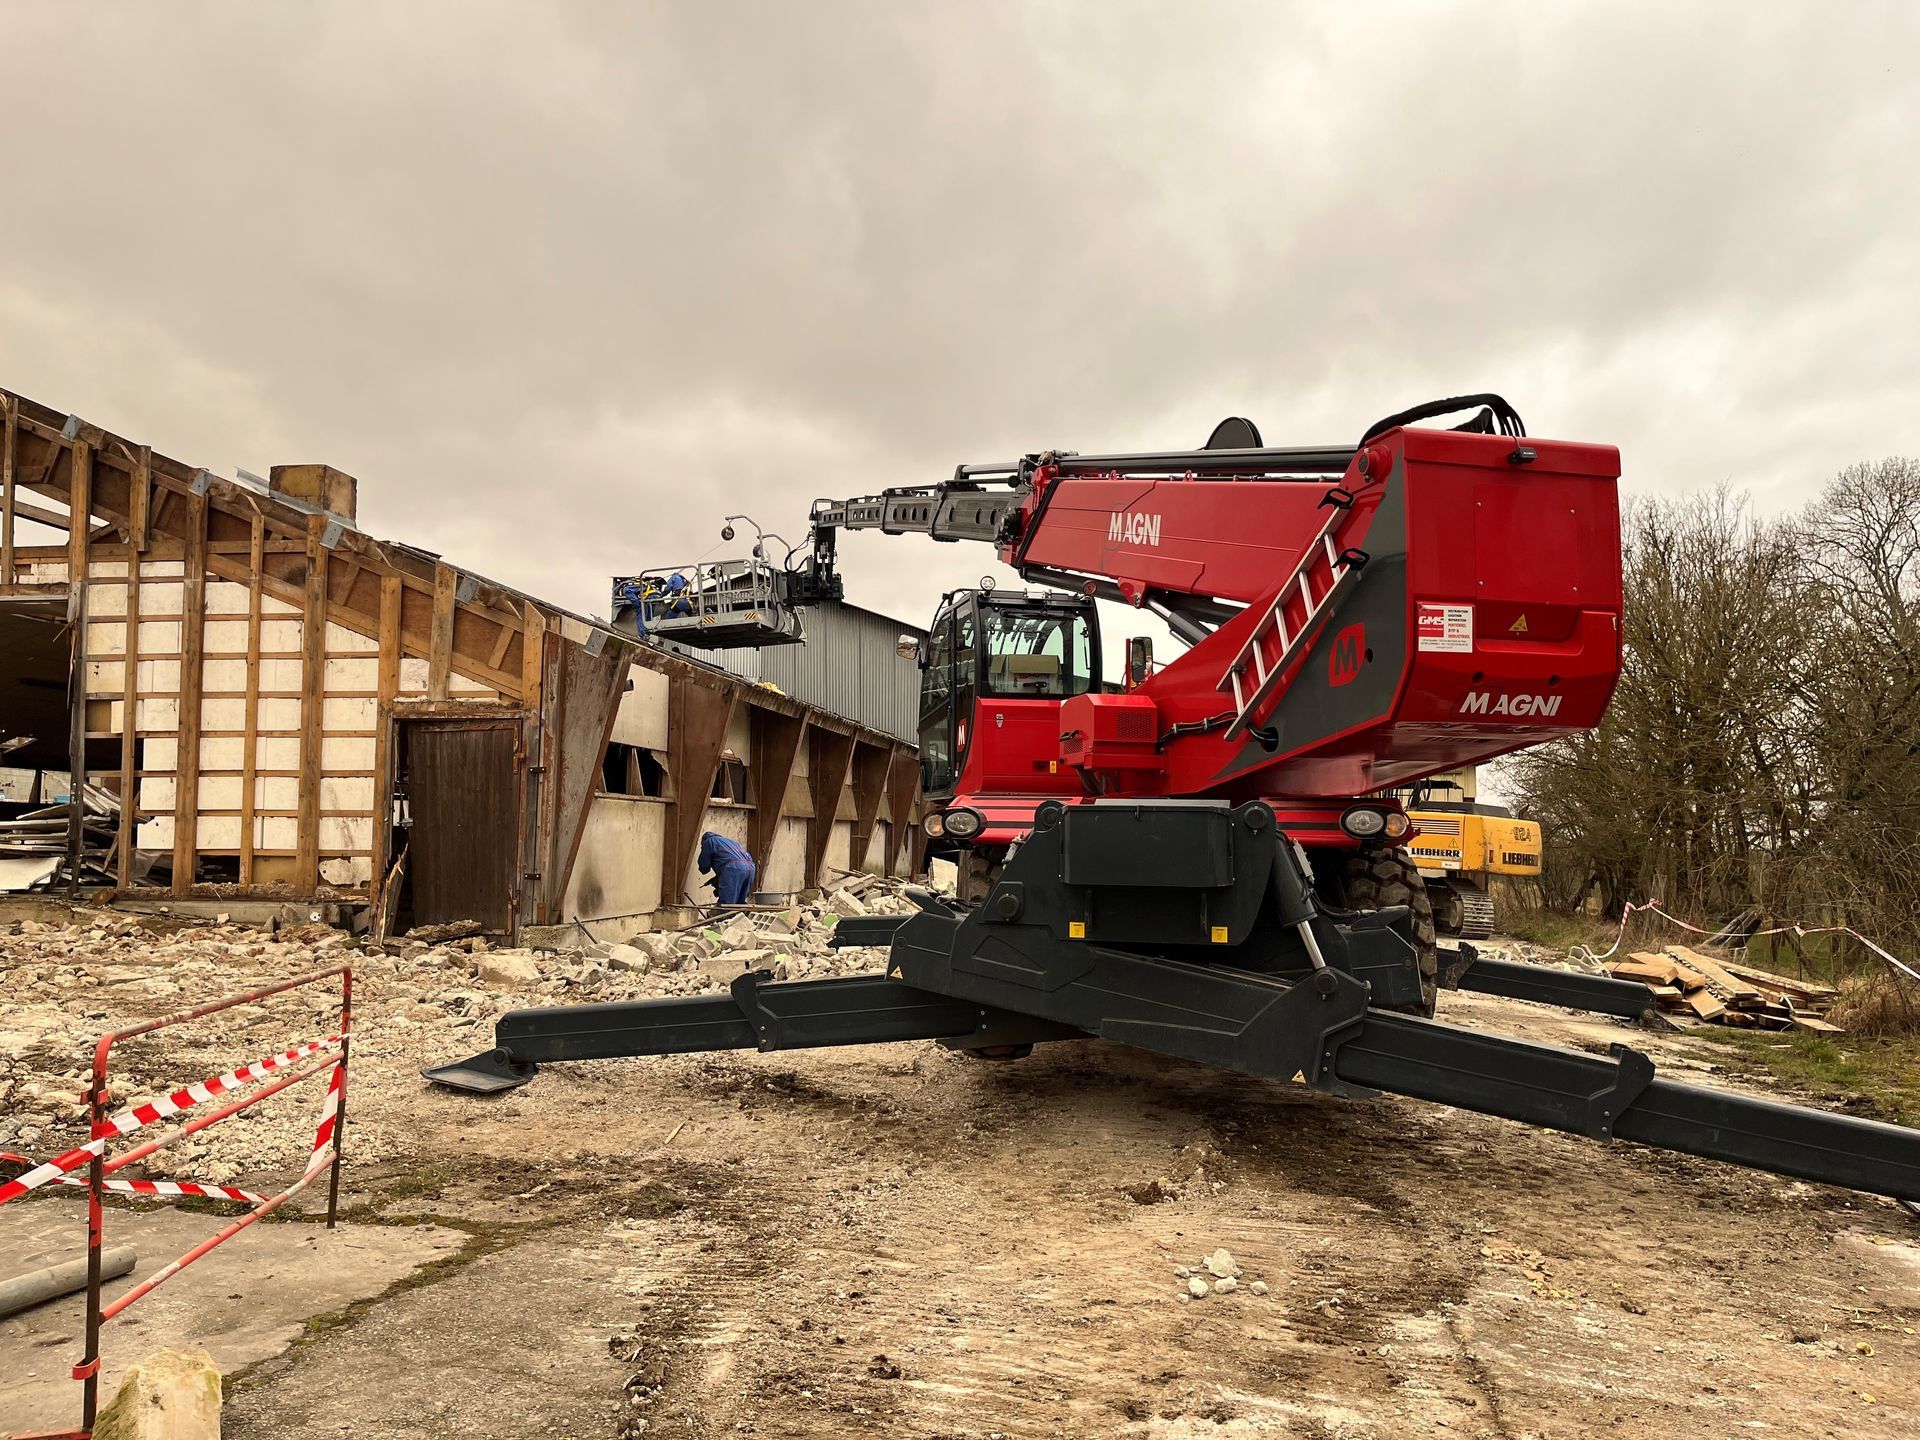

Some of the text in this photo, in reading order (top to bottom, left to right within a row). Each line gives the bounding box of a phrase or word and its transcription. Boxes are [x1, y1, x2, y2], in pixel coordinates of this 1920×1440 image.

[1108, 512, 1161, 546] MAGNI
[1418, 616, 1444, 625] GMS
[1335, 636, 1358, 676] M
[1459, 691, 1562, 717] MAGNI
[958, 724, 966, 746] M
[1513, 826, 1532, 842] 924
[1411, 847, 1460, 858] LIEBHERR
